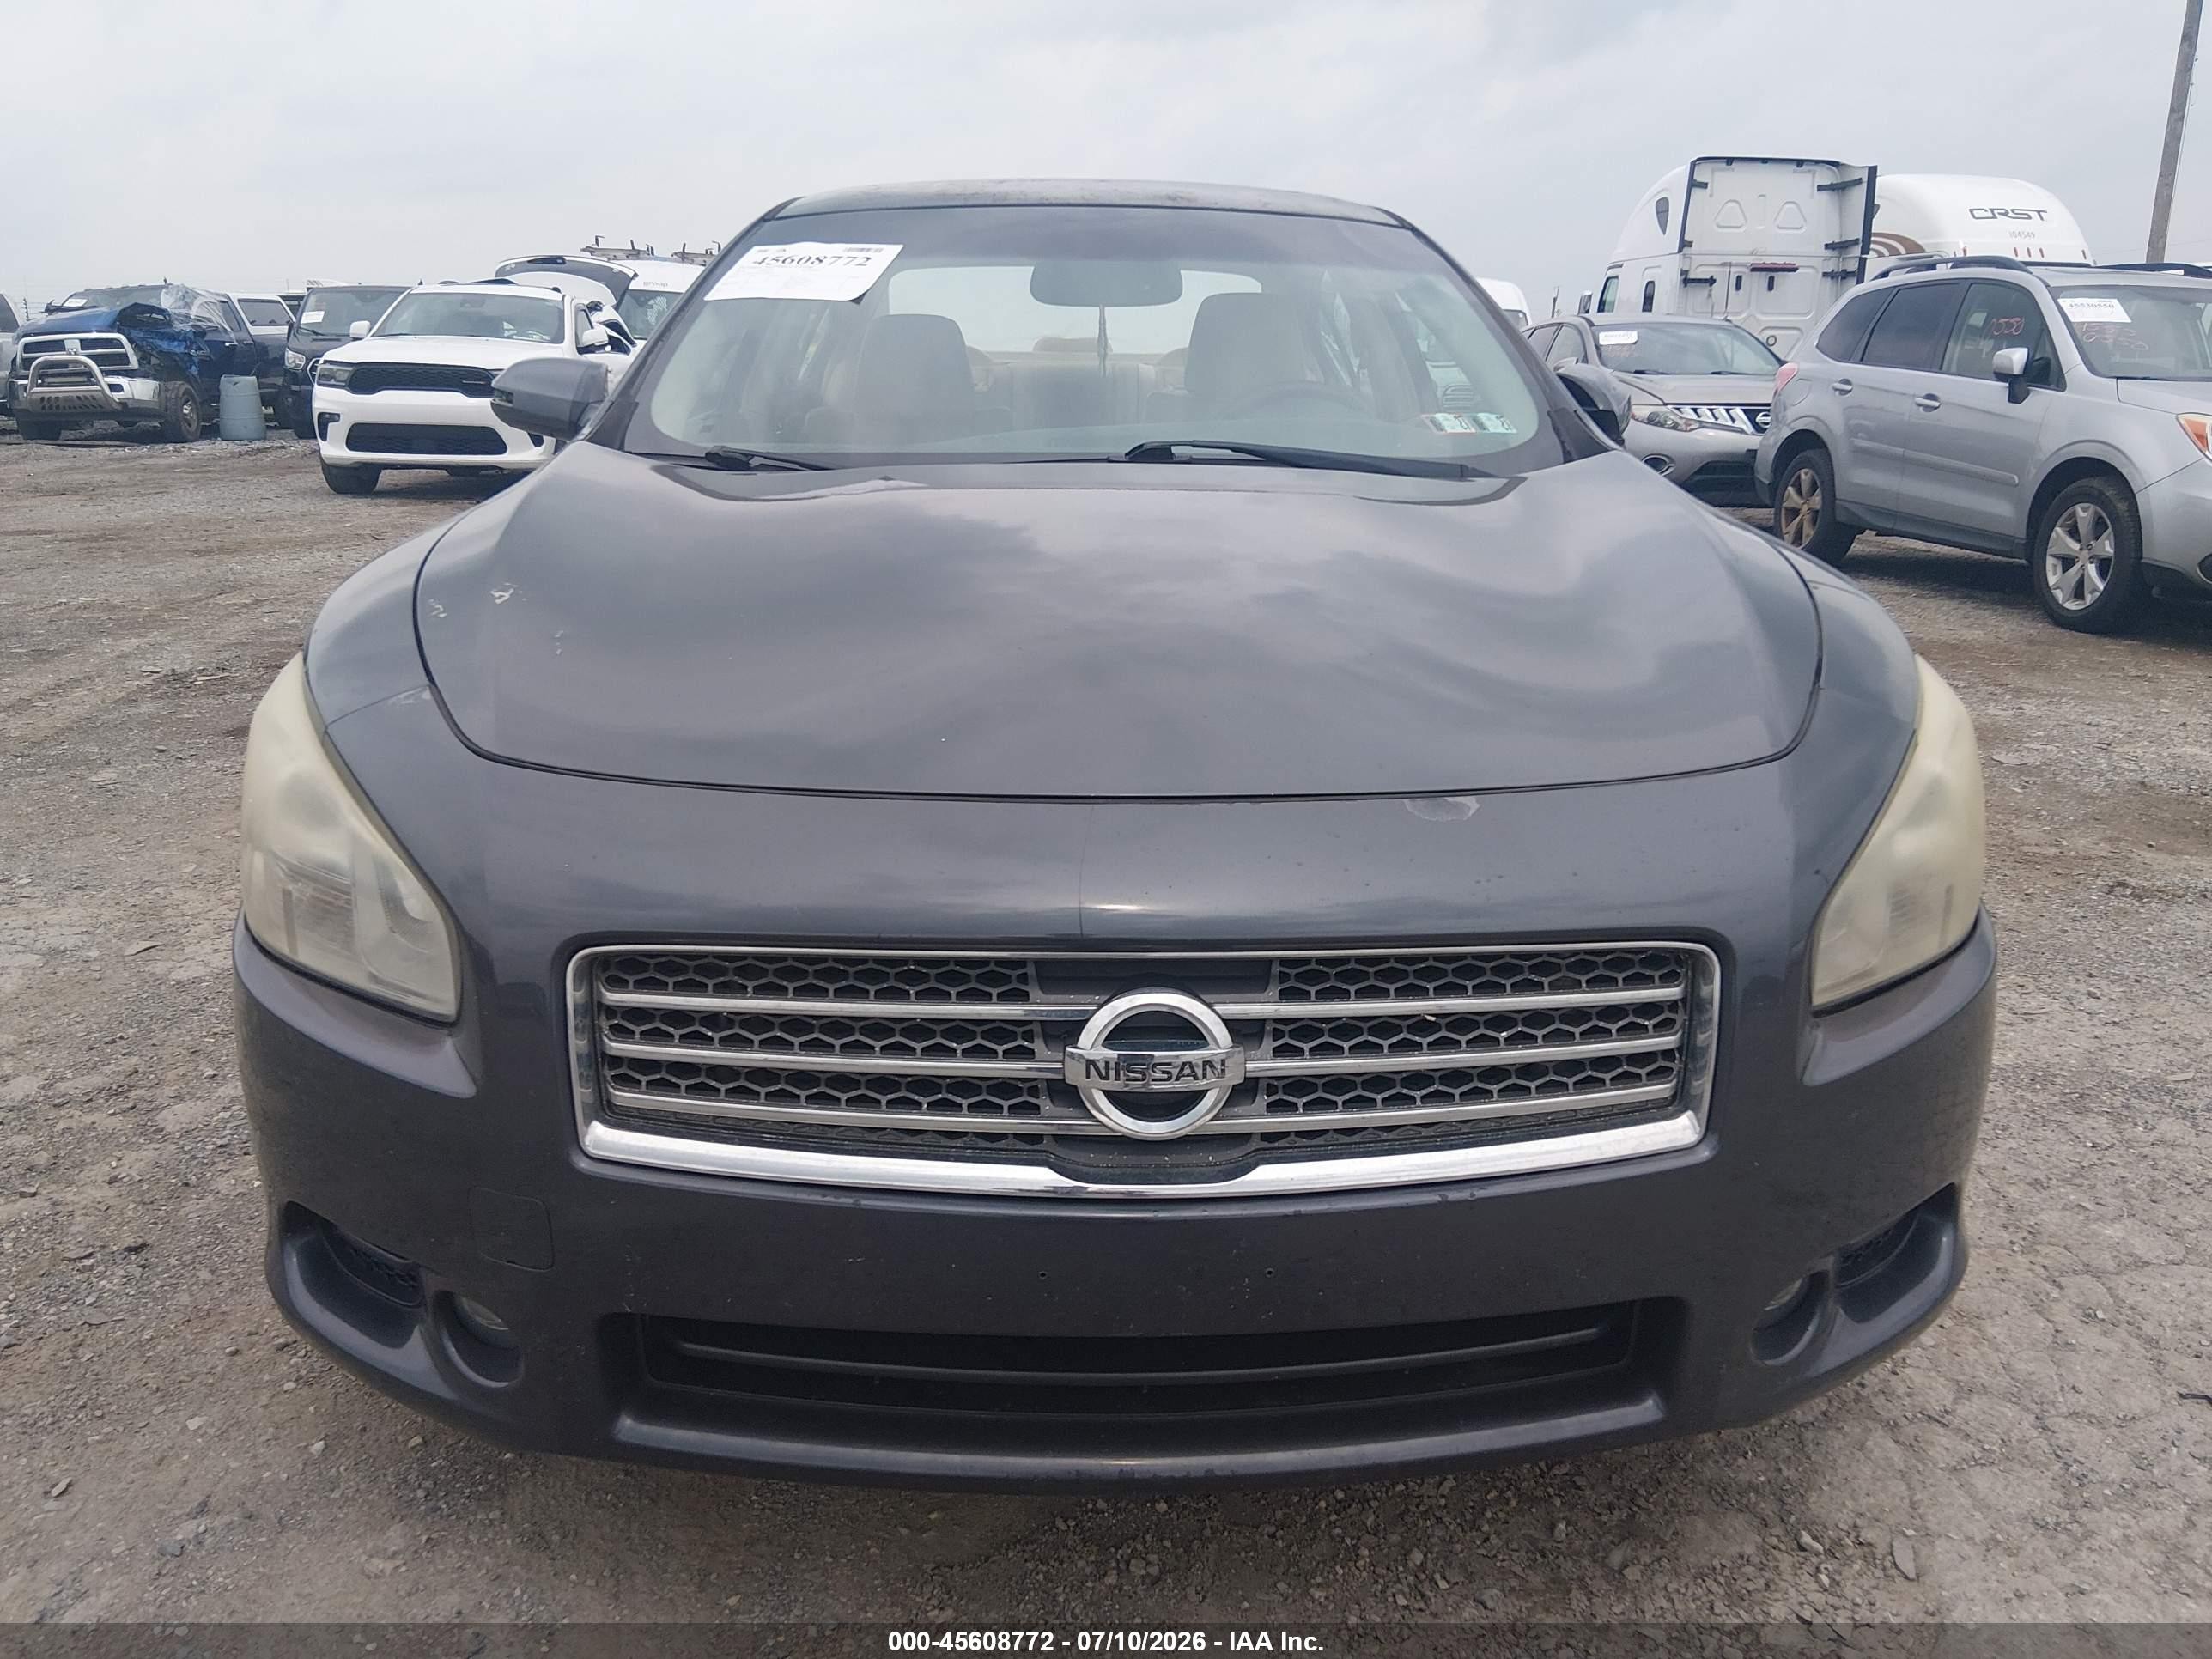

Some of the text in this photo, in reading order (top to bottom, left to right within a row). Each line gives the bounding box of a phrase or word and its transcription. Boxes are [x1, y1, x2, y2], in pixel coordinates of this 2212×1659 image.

[1969, 208, 2047, 221] CRST
[752, 256, 872, 266] 45608772
[1085, 1059, 1225, 1081] NISSAN
